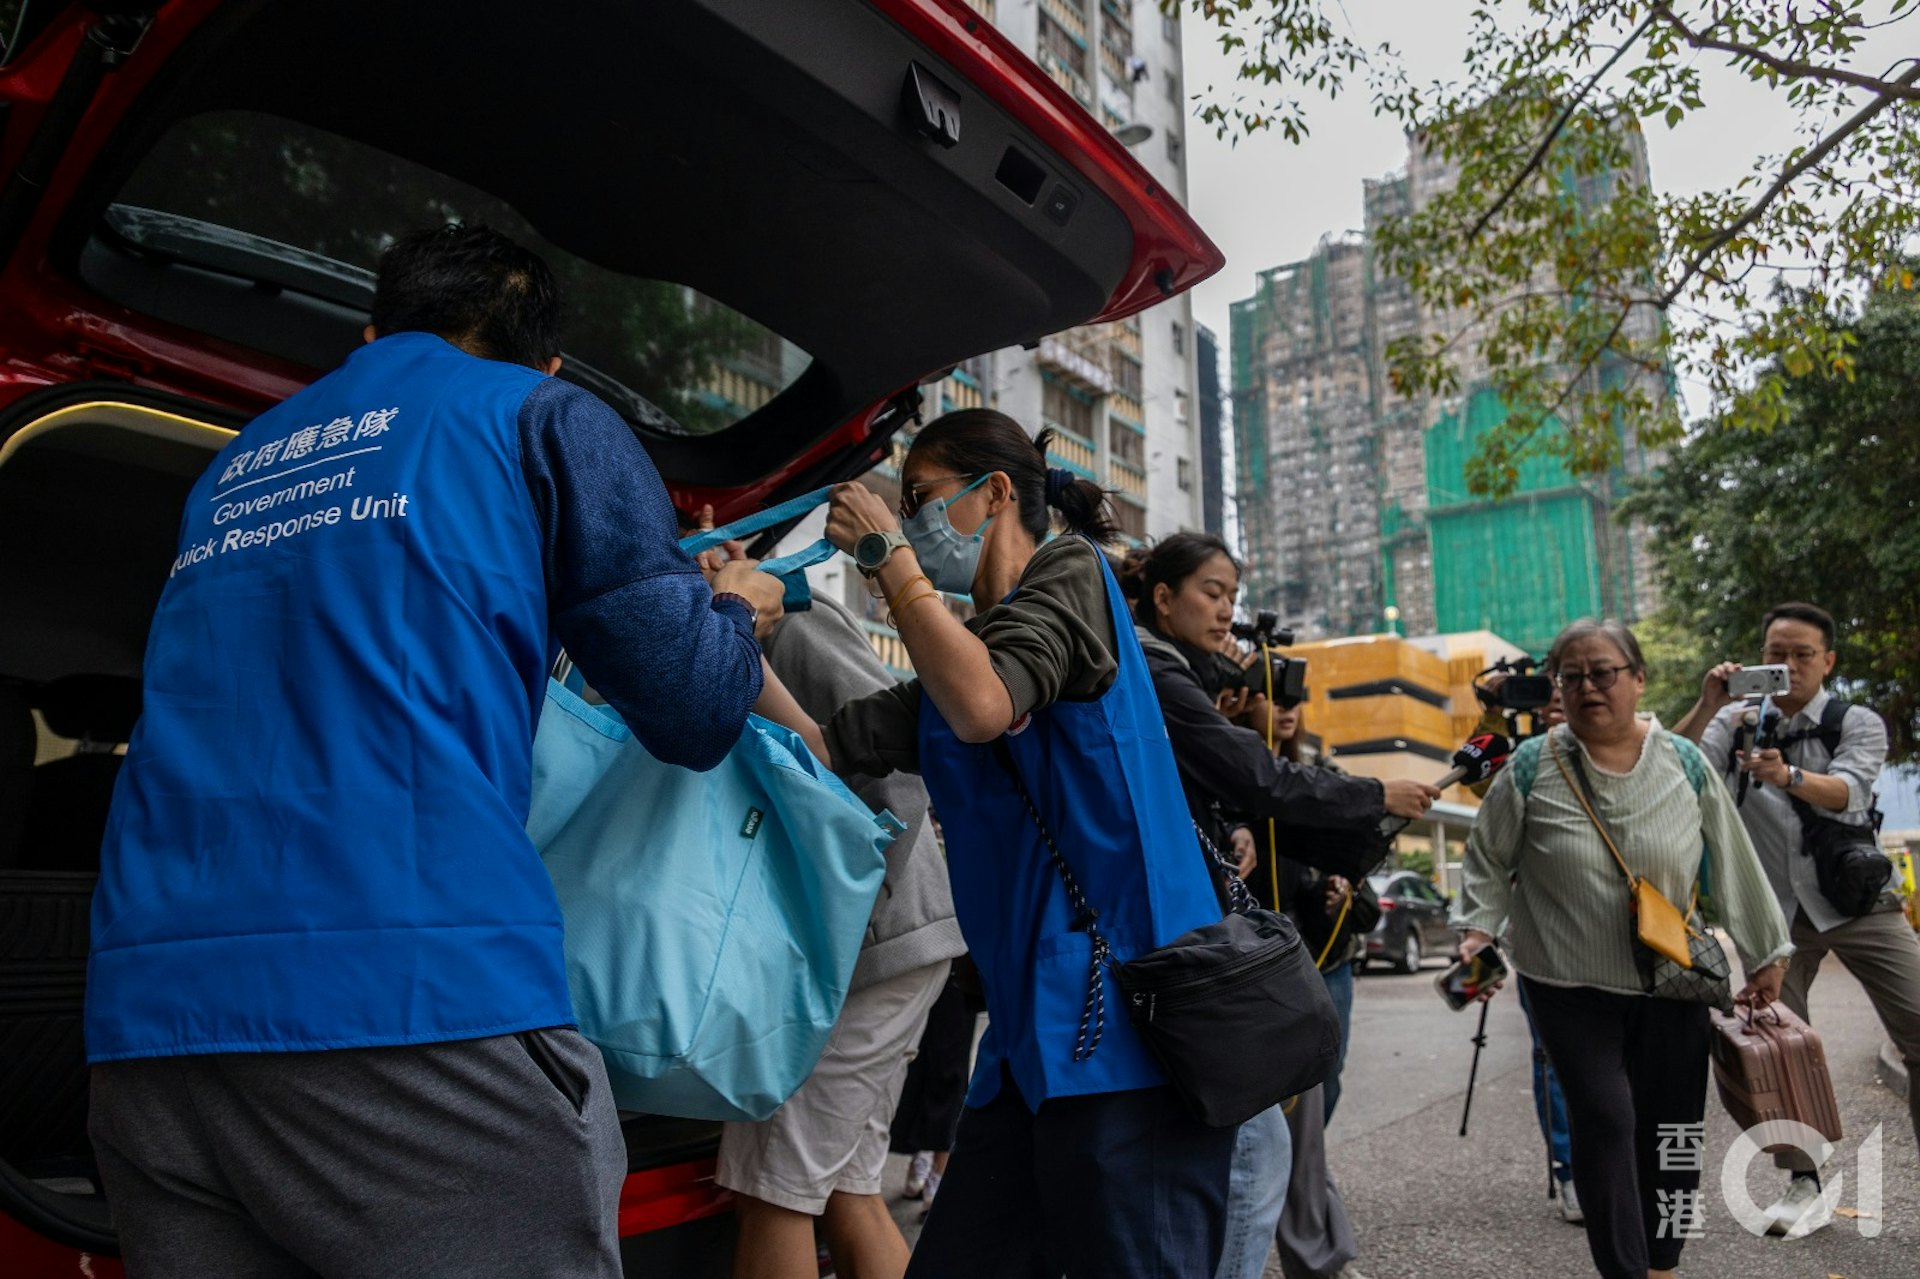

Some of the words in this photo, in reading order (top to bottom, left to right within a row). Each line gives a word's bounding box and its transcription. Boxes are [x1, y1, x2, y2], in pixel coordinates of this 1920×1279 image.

[217, 407, 399, 485] 政府應急隊
[213, 466, 355, 525] Government
[170, 537, 218, 578] uick
[220, 506, 342, 554] Response
[350, 492, 409, 521] Unit
